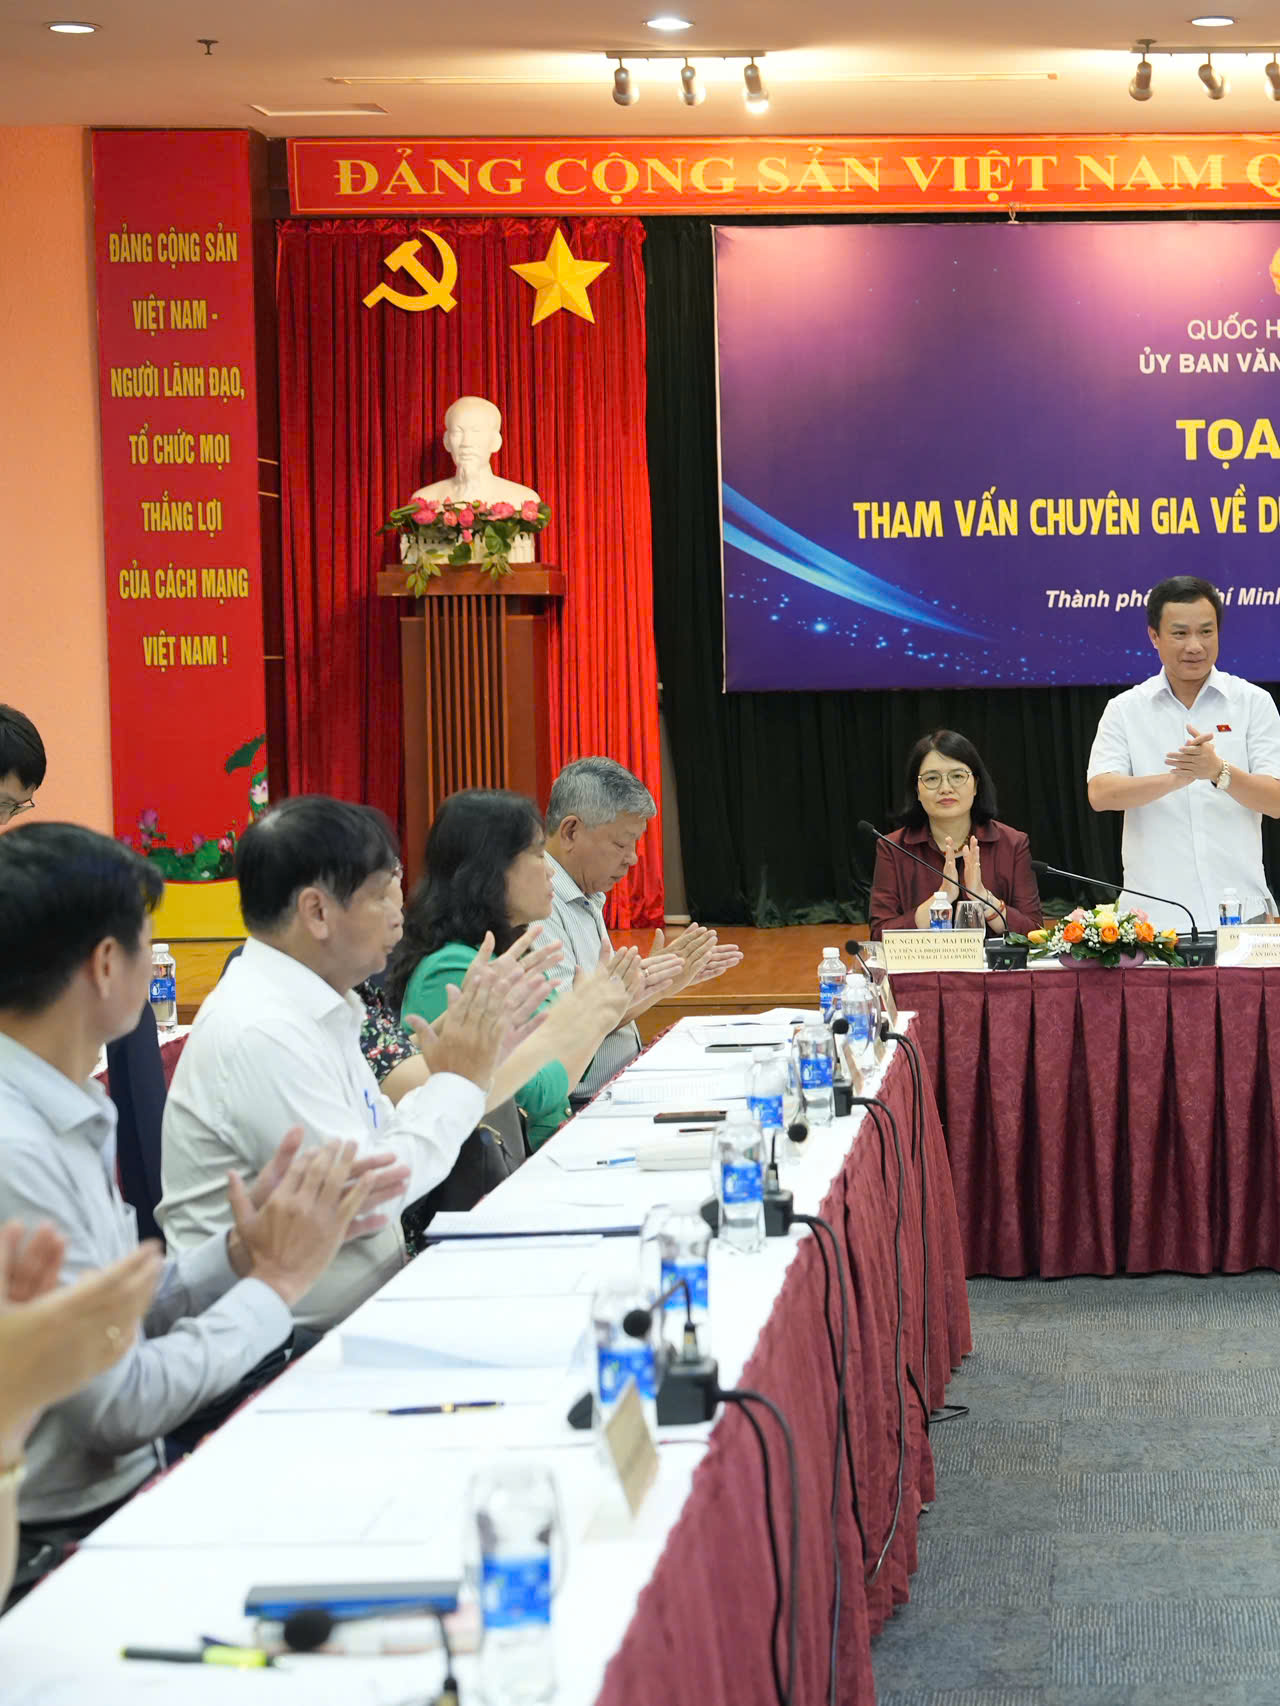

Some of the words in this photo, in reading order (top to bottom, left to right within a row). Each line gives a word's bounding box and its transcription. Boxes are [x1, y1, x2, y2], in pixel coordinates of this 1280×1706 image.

[333, 147, 525, 197] ĐẢNG
[544, 151, 737, 206] CỘNG
[757, 146, 882, 193] SẢN
[903, 150, 1058, 203] VIỆT
[1077, 153, 1227, 192] NAM
[109, 224, 153, 262] ĐẢNG
[157, 229, 201, 268] CỘNG
[205, 223, 238, 262] SẢN
[133, 294, 166, 337] VIỆT
[170, 300, 207, 329] NAM
[1186, 311, 1258, 341] QUỐC
[111, 360, 160, 398] NGƯỜI
[163, 362, 205, 397] LÃNH
[209, 366, 245, 403] ĐẠO,
[1139, 345, 1172, 375] ỦY
[1178, 352, 1229, 374] BAN
[129, 423, 149, 465] TỔ
[153, 431, 195, 465] CHỨC
[199, 433, 230, 471] MỌI
[142, 491, 194, 531] THẮNG
[197, 498, 223, 537] LỢI
[852, 500, 944, 539] THAM
[954, 486, 1018, 537] VẤN
[1029, 489, 1140, 536] CHUYÊN
[1151, 497, 1200, 535] GIA
[1210, 483, 1247, 534] VỀ
[119, 559, 151, 600] CỦA
[155, 562, 197, 599] CÁCH
[201, 567, 249, 604] MẠNG
[1046, 589, 1110, 608] Thành
[1215, 587, 1234, 606] hí
[143, 629, 177, 672] VIỆT
[180, 635, 218, 665] NAM
